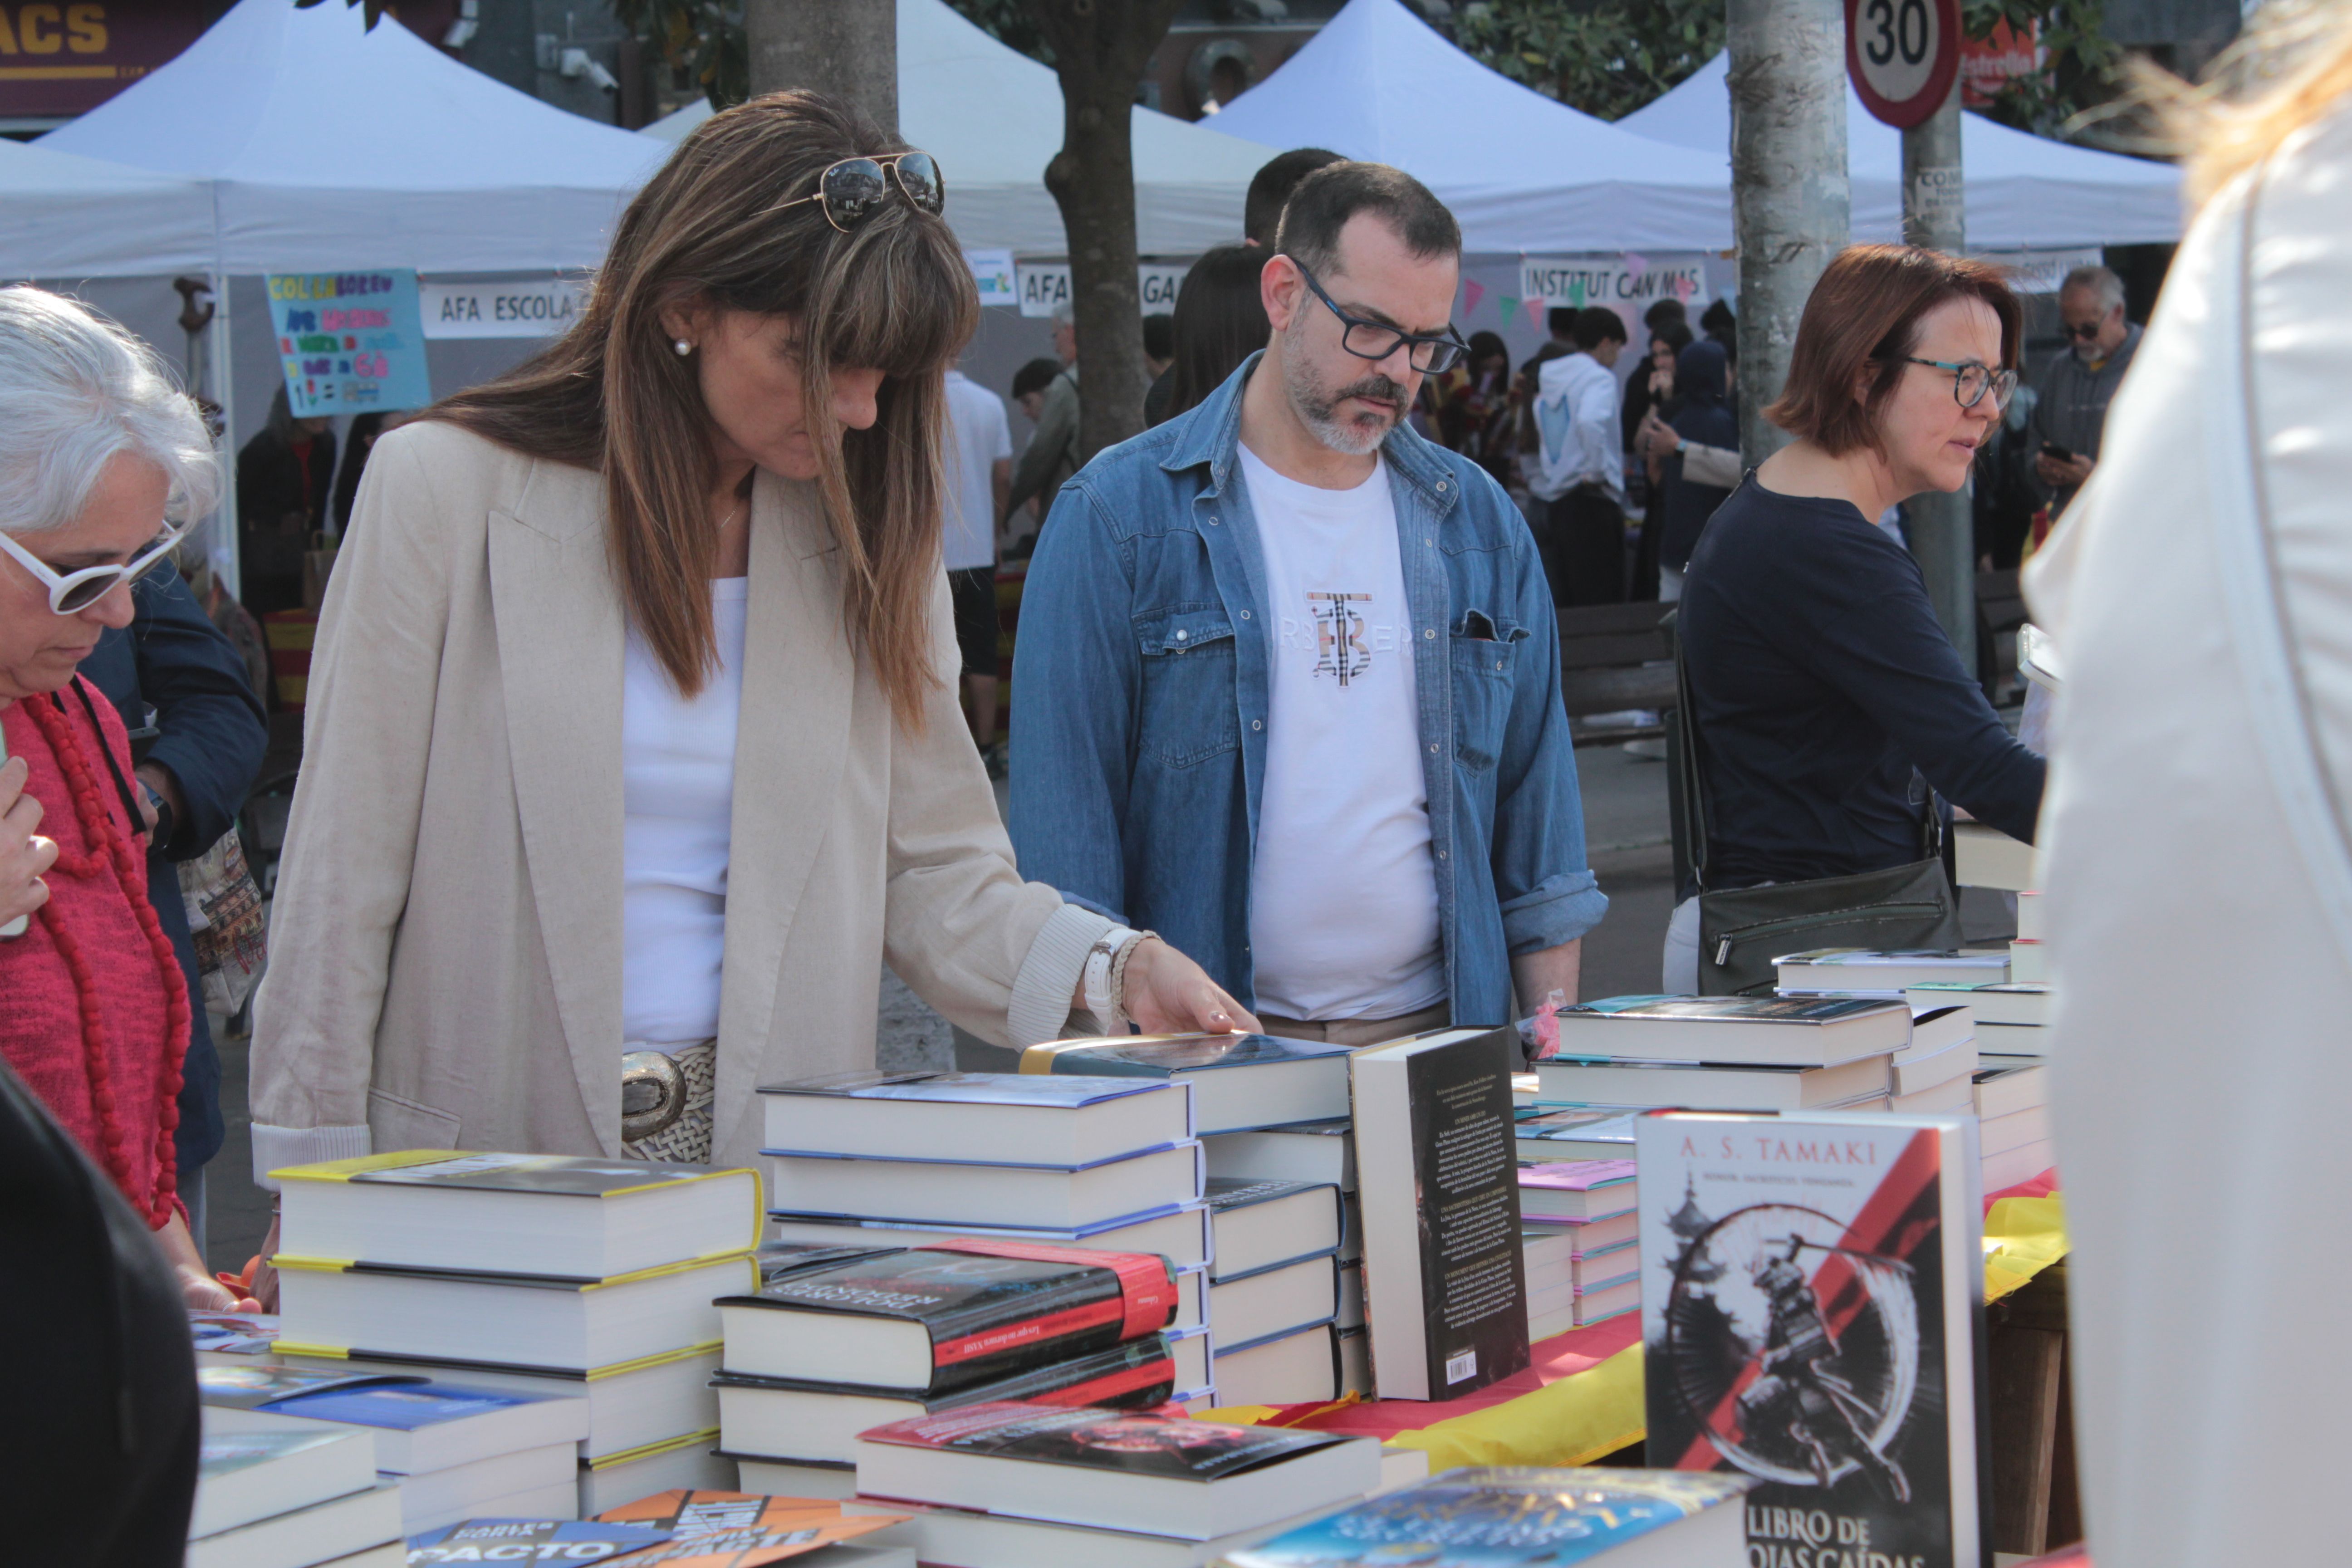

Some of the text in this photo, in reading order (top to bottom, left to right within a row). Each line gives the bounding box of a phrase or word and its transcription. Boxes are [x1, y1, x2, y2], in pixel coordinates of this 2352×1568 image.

[1866, 0, 1928, 67] 30
[1025, 274, 1068, 304] AFA
[441, 296, 481, 321] AFA
[495, 295, 573, 321] ESCOLA
[1681, 1136, 1877, 1165] A. S. TAMAKI
[1748, 1505, 1871, 1550] LIBRO DE
